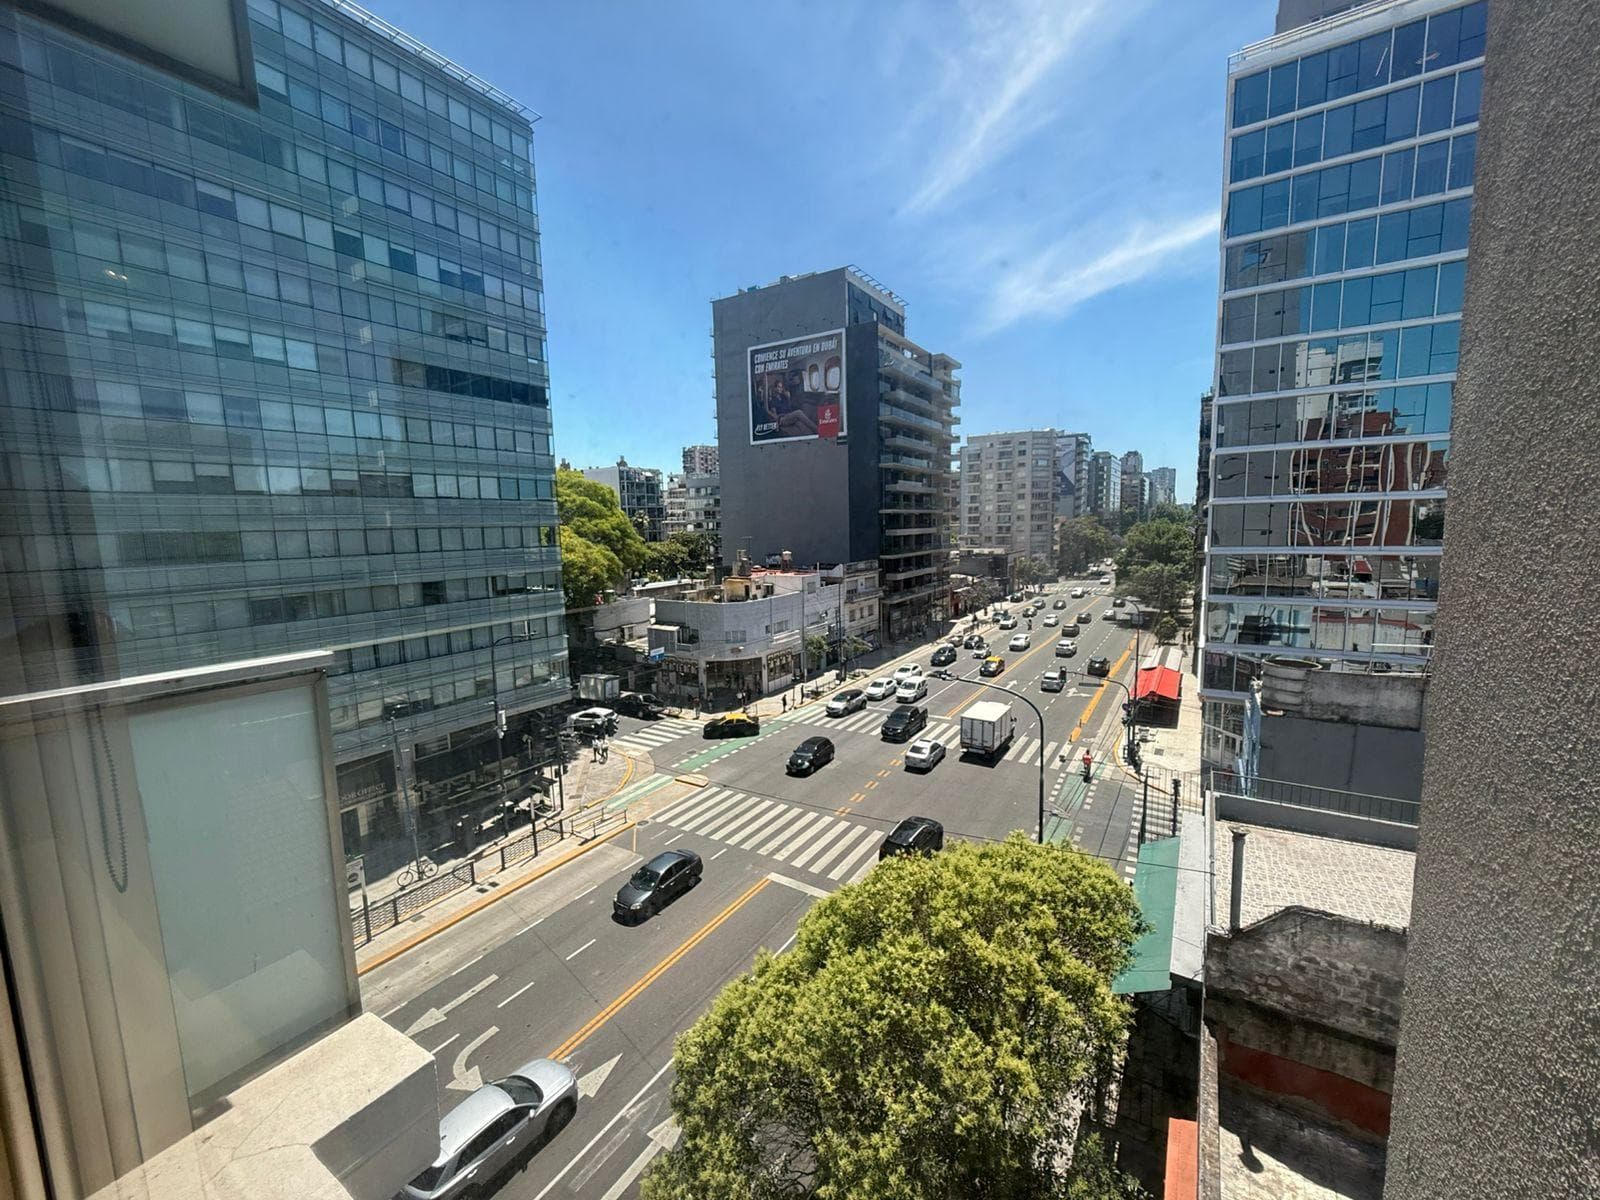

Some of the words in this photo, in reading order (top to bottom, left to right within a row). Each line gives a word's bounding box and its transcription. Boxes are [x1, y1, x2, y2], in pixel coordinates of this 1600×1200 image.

[754, 351, 778, 364] COMIENCE
[787, 345, 811, 358] AVENTURA
[813, 342, 820, 353] EN
[754, 364, 765, 374] CON
